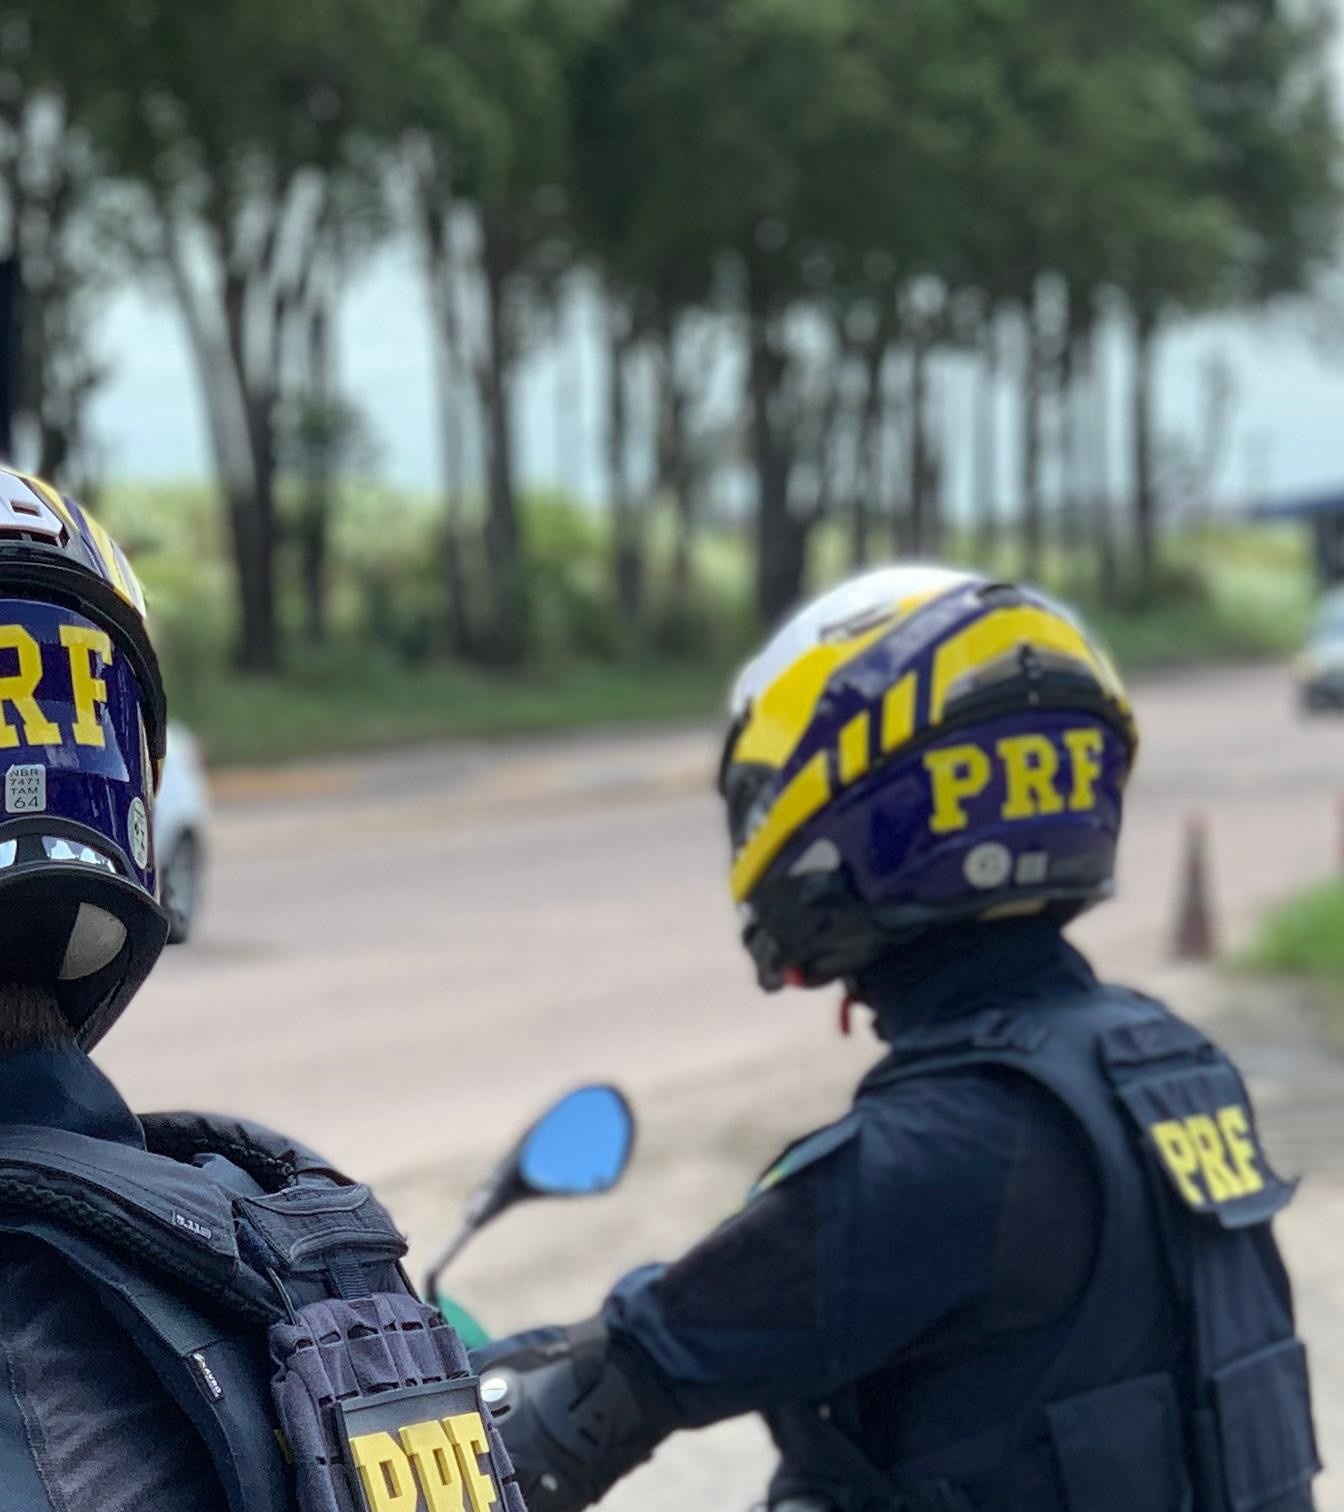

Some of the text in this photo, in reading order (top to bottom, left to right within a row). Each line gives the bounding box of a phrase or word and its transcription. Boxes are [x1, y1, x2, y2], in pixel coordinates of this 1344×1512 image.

[9, 768, 40, 777] NBR
[9, 778, 40, 786] 7471
[923, 729, 1104, 833] PRF
[10, 787, 39, 795] TAM
[14, 796, 39, 809] 64
[1152, 1105, 1264, 1206] PRF
